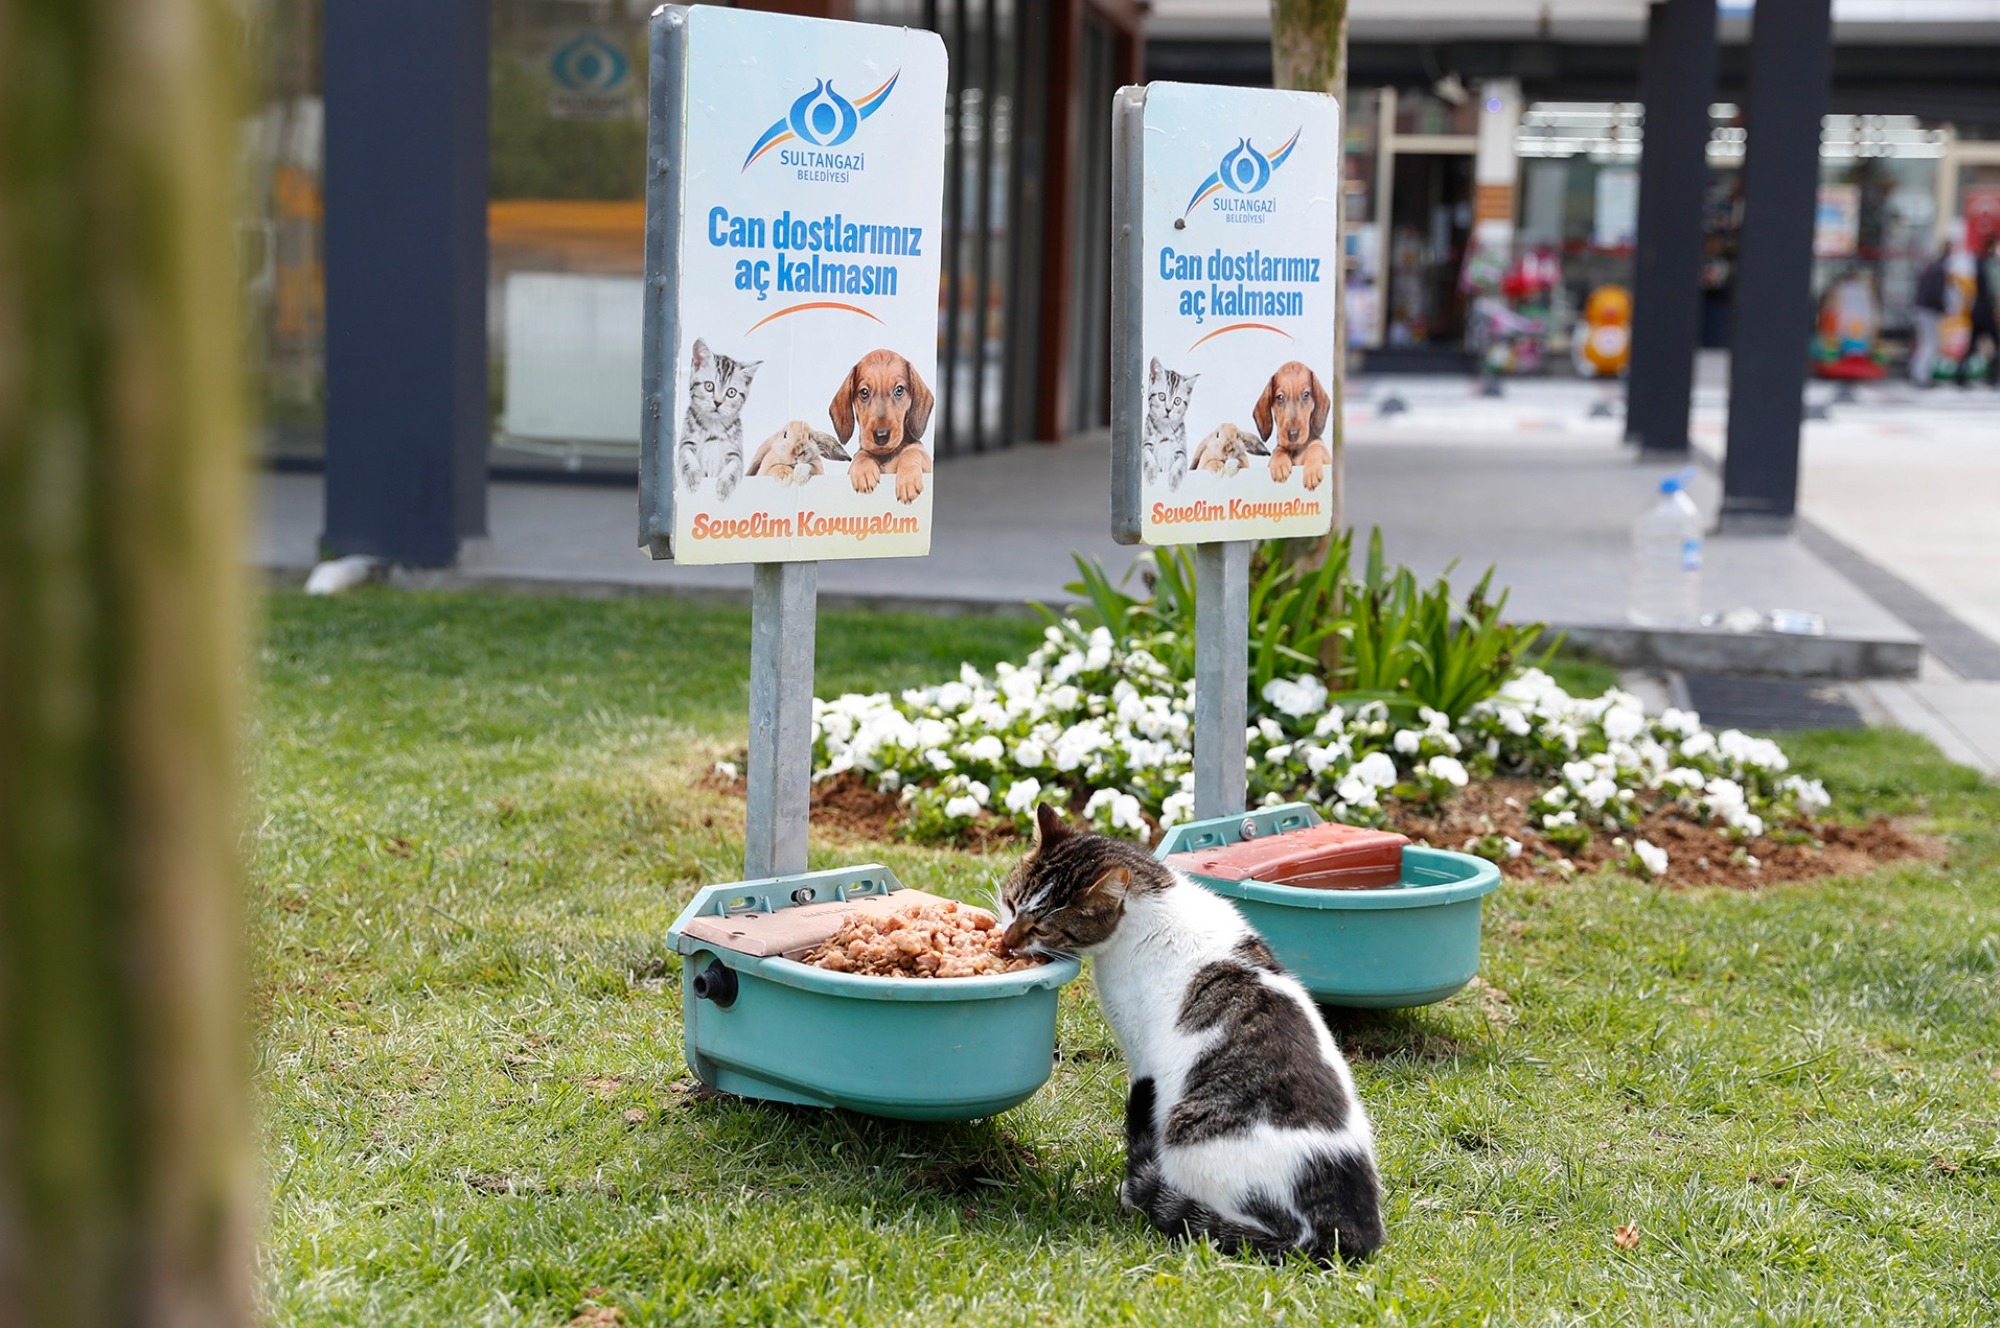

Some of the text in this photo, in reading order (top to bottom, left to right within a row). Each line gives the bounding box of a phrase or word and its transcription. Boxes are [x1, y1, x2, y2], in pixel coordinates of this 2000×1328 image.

[780, 149, 865, 171] SULTANGAZİ
[797, 169, 850, 184] BELEDİYESİ
[1212, 197, 1276, 213] SULTANGAZİ
[1225, 213, 1265, 224] BELEDİYESİ
[708, 206, 923, 257] Can dostlarımız
[734, 252, 898, 301] aç kalmasın
[1159, 246, 1321, 283] Can dostlarımız
[1179, 283, 1304, 324] aç kalmasın
[691, 511, 919, 541] Sevelim Koruyalım
[1151, 498, 1321, 526] Sevelim Koruyalım
